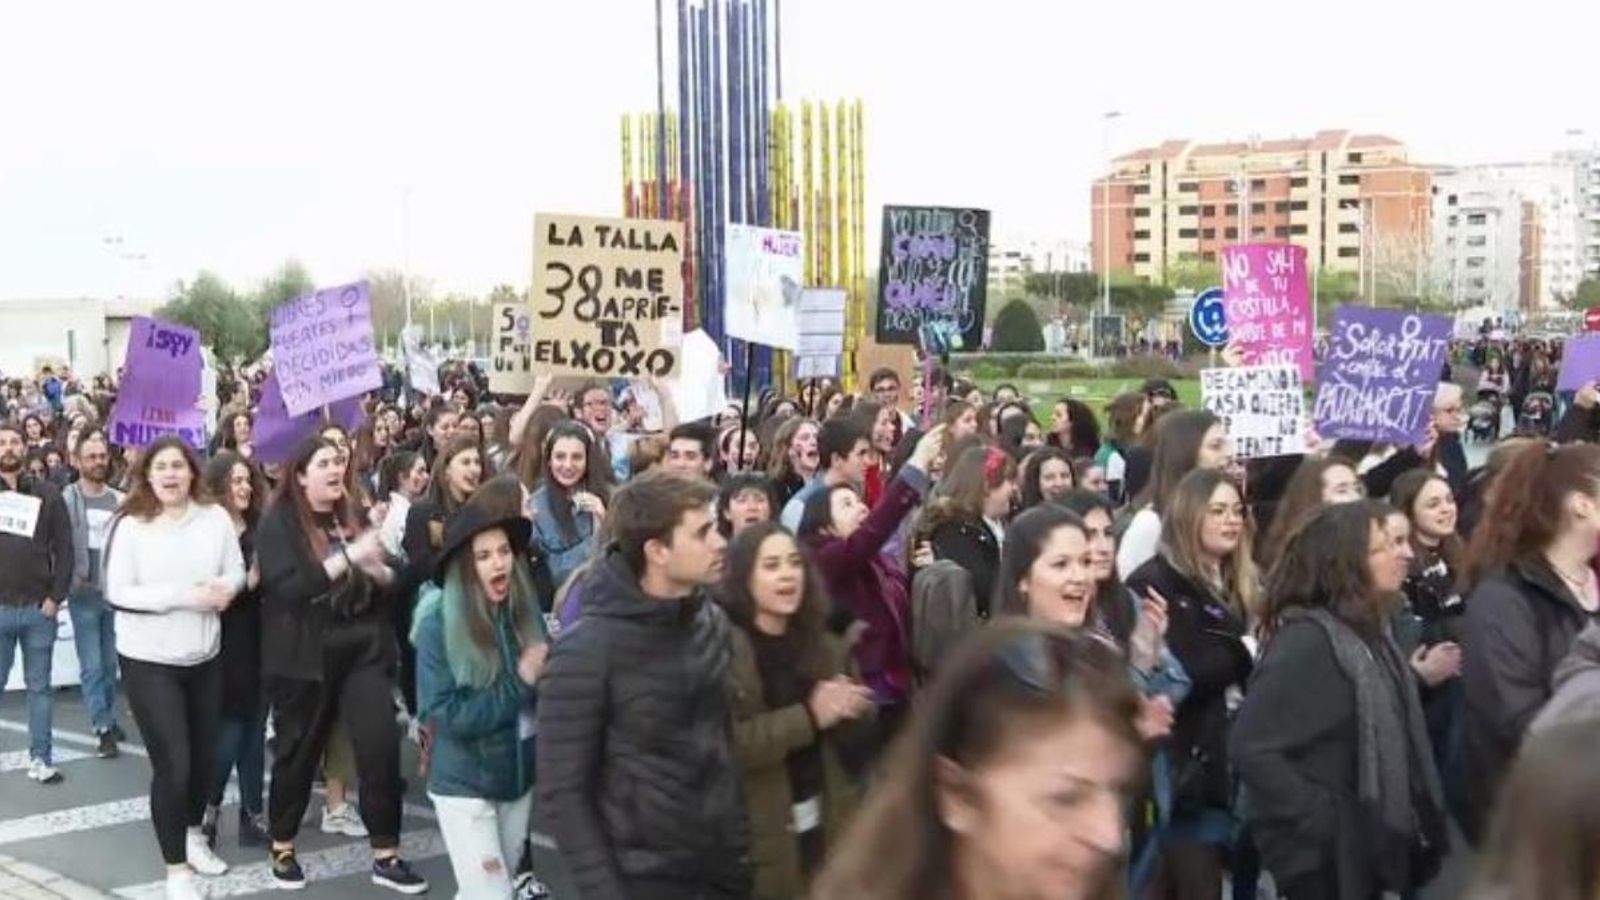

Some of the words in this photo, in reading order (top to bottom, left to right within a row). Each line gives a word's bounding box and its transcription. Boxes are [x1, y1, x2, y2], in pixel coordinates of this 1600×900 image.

[548, 222, 583, 247] LA
[594, 225, 678, 252] TALLA
[538, 262, 602, 322] 38
[615, 267, 663, 293] ME
[595, 320, 640, 347] TA
